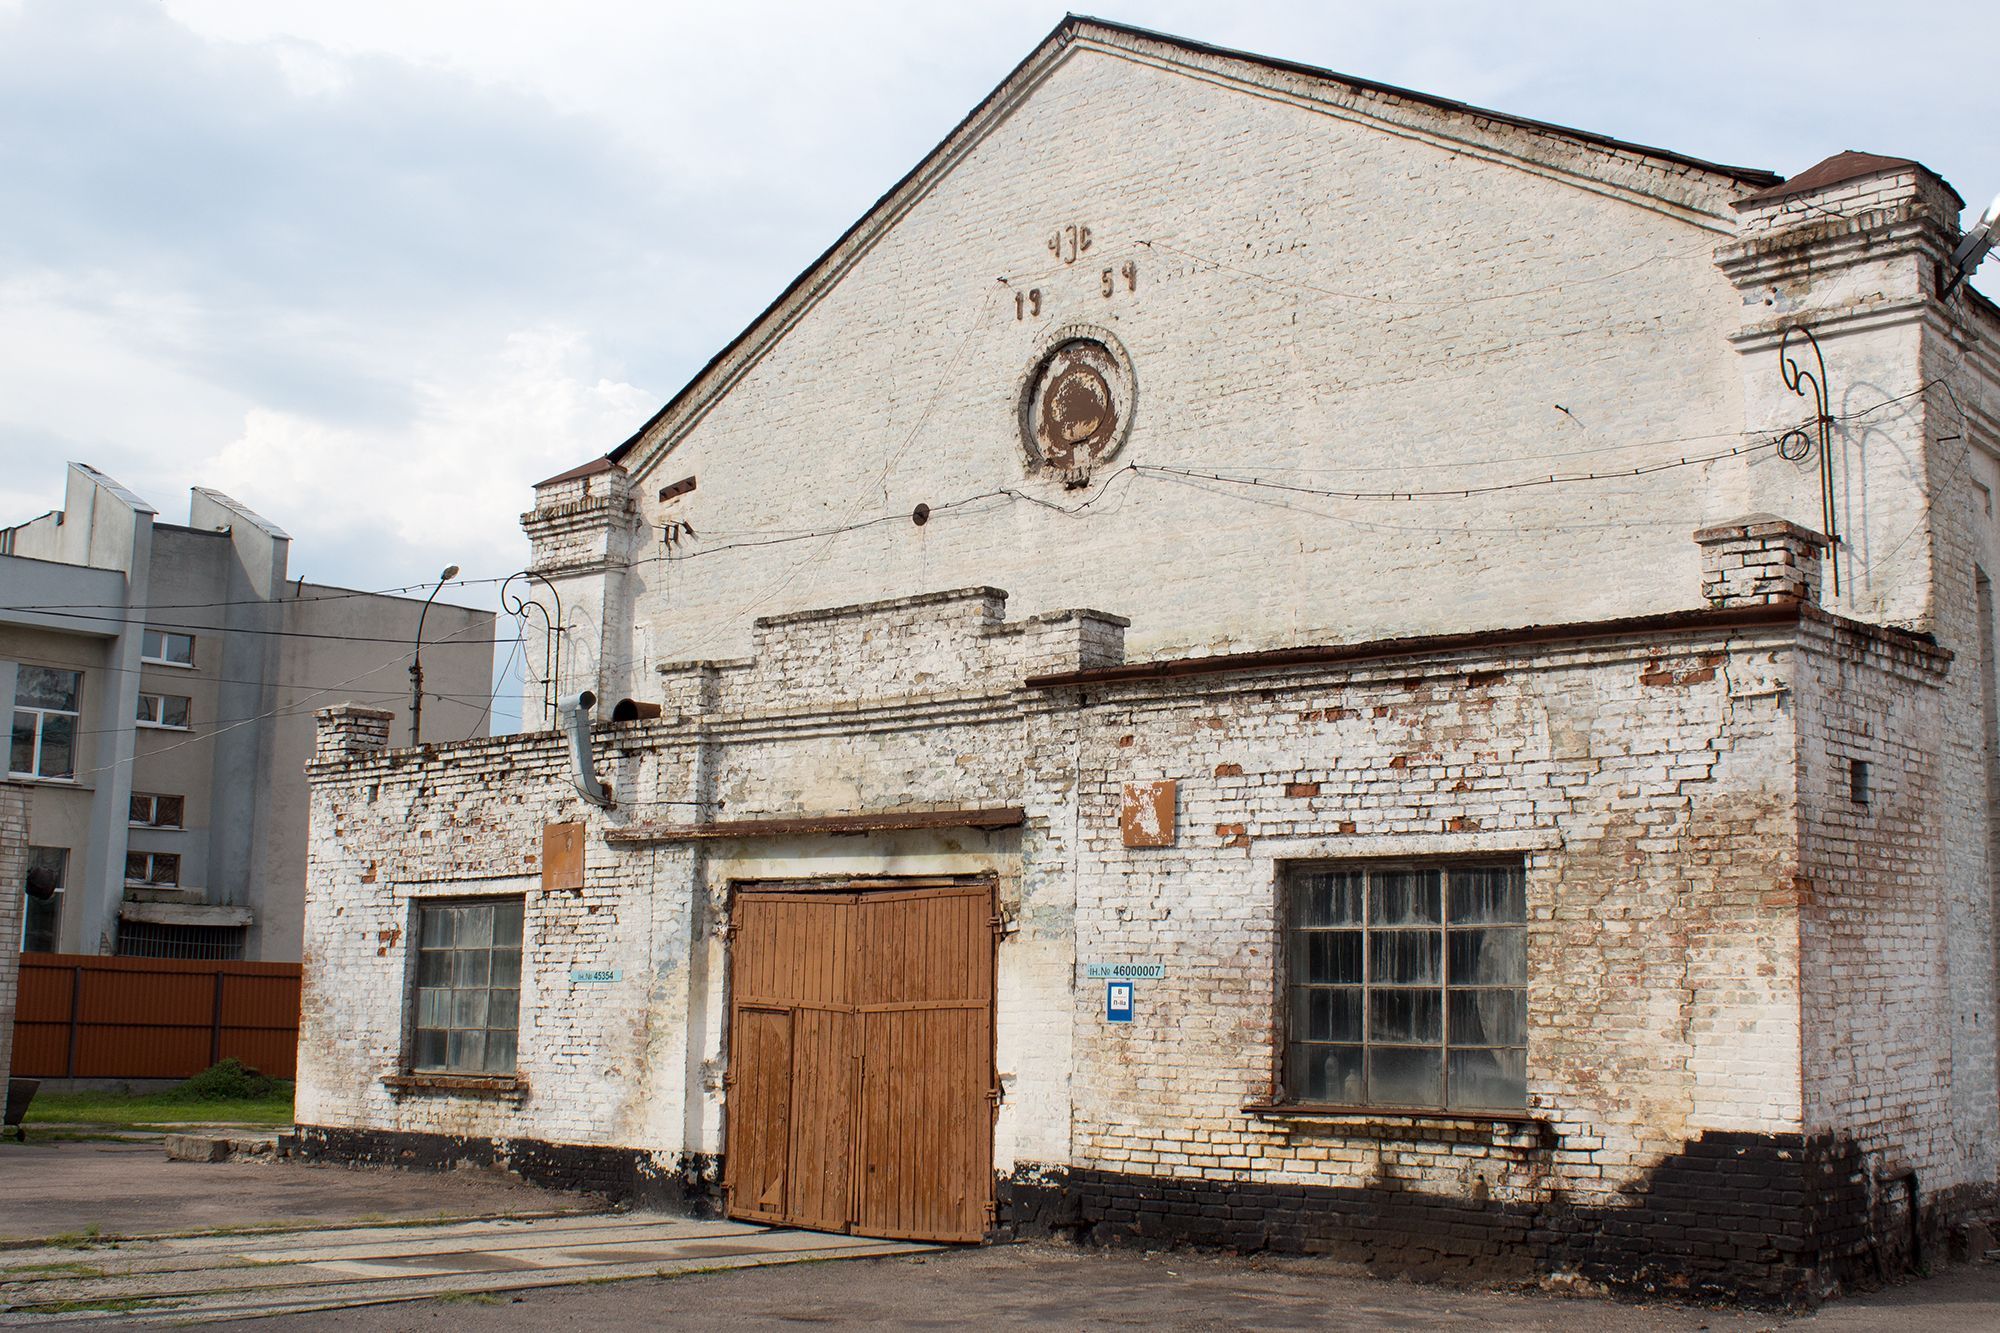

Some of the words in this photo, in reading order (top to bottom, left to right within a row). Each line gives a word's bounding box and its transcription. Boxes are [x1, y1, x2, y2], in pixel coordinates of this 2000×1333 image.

[1015, 288, 1041, 321] 19
[594, 971, 614, 980] 45354
[1113, 965, 1161, 976] 46000007
